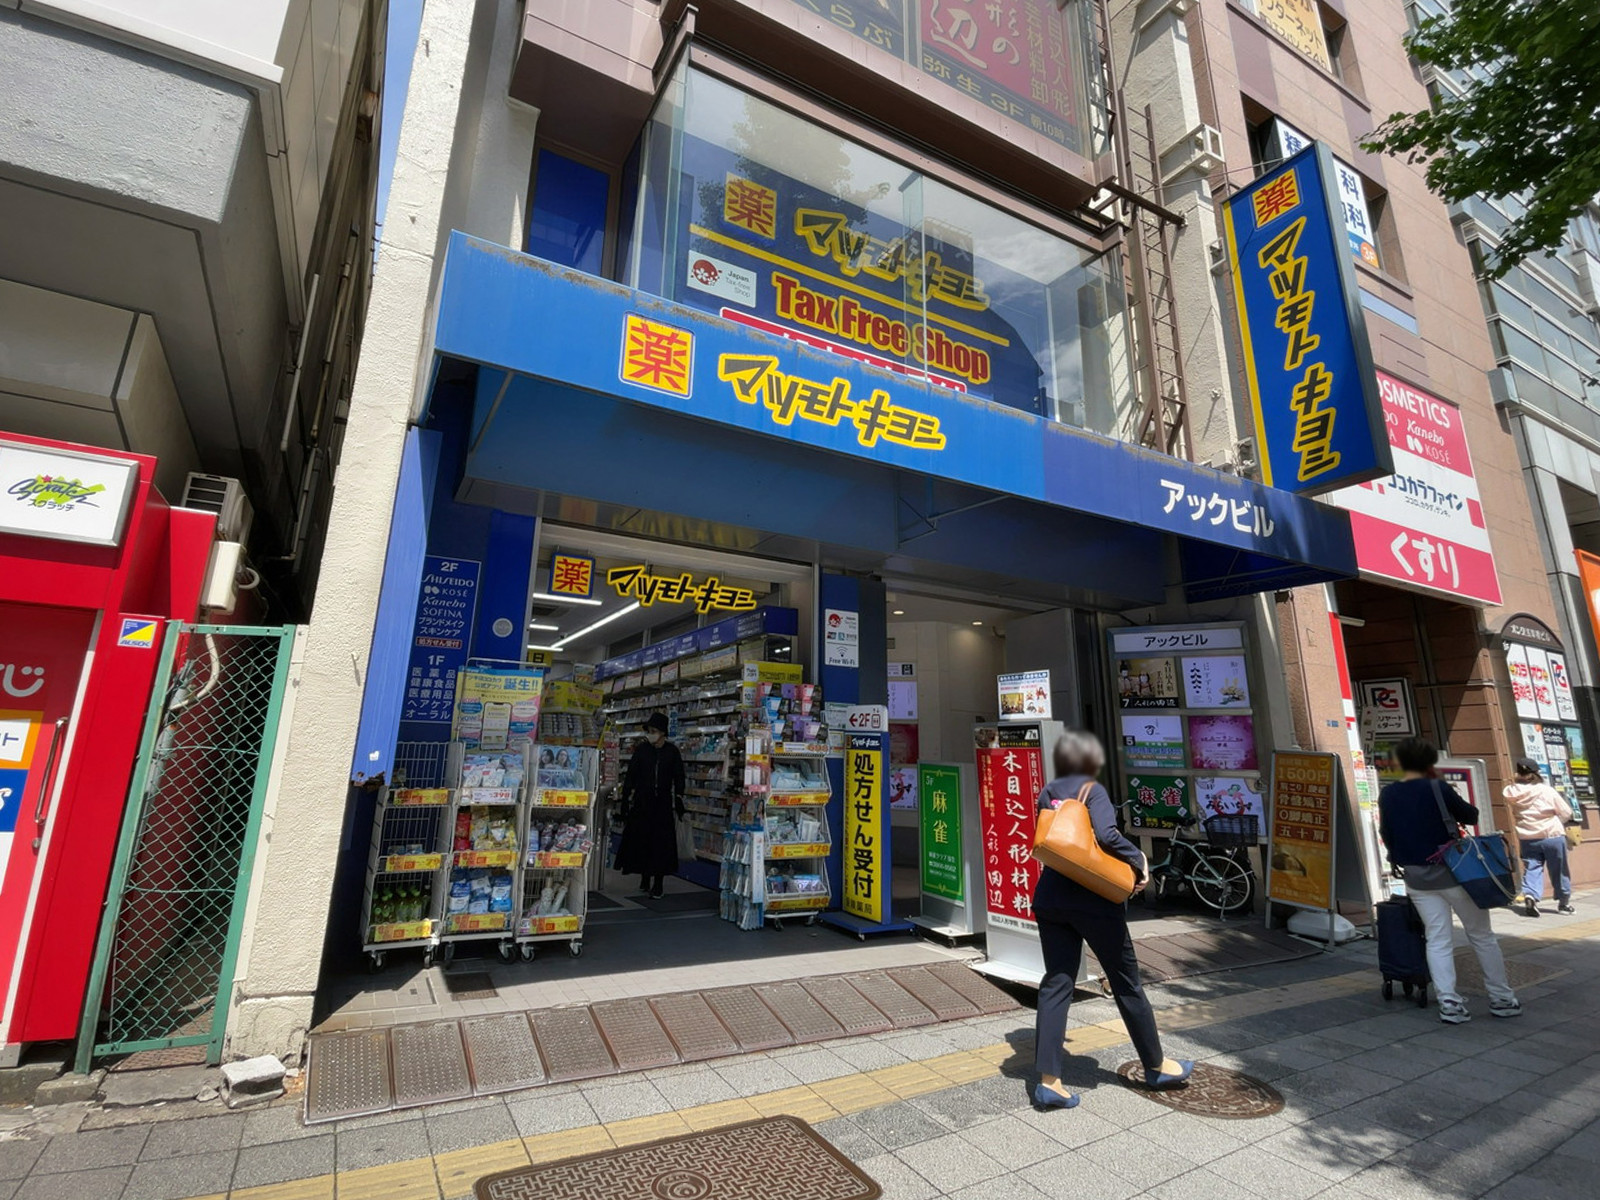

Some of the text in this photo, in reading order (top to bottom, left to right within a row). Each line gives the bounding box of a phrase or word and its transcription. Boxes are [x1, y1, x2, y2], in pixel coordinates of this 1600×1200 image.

[923, 53, 984, 99] 弥生
[990, 92, 1025, 117] 3F
[724, 174, 776, 238] 薬
[1254, 171, 1301, 226] 薬
[728, 271, 749, 283] Japan
[773, 272, 837, 333] Tax
[838, 298, 911, 357] Free
[911, 322, 992, 384] Shop
[627, 318, 688, 394] 薬
[1258, 215, 1341, 482] マツモトキヨシ
[718, 354, 946, 450] マツモトキヨシ
[1407, 418, 1445, 446] Kanebo
[1425, 442, 1452, 465] KOSÉ
[1387, 471, 1463, 511] ココカラファイン
[27, 497, 75, 512] スクラッチ
[1160, 478, 1275, 537] アックビル
[440, 561, 460, 572] 2F
[1390, 531, 1459, 590] くすり
[421, 573, 475, 588] SHISEIDO
[554, 557, 592, 596] 薬
[441, 587, 469, 598] KOSÉ
[607, 564, 758, 614] マツモトキヨシ
[422, 595, 467, 608] Kanebo
[422, 606, 463, 619] SOFINA
[418, 616, 465, 629] ブランドメイク
[420, 626, 461, 637] スキンケア
[119, 639, 150, 647] ALSOK
[1144, 634, 1208, 648] アックビル
[428, 655, 446, 666] 1F
[412, 667, 456, 679] 医薬品
[410, 677, 456, 690] 健康食品
[407, 699, 452, 710] ヘアケア
[1122, 698, 1130, 708] 7
[405, 708, 450, 720] オーラル
[858, 712, 871, 728] 2F
[1126, 736, 1134, 746] 5
[1363, 730, 1375, 765] ゴルフ
[1136, 785, 1183, 807] 麻雀
[1278, 793, 1328, 809] 骨盤矯正
[932, 789, 948, 844] 麻雀
[1133, 816, 1142, 827] 3
[853, 752, 875, 899] 処方せん受付
[1279, 825, 1325, 842] 五十肩
[1002, 750, 1033, 918] 木目込人形材料
[986, 823, 1005, 910] 人形の田辺
